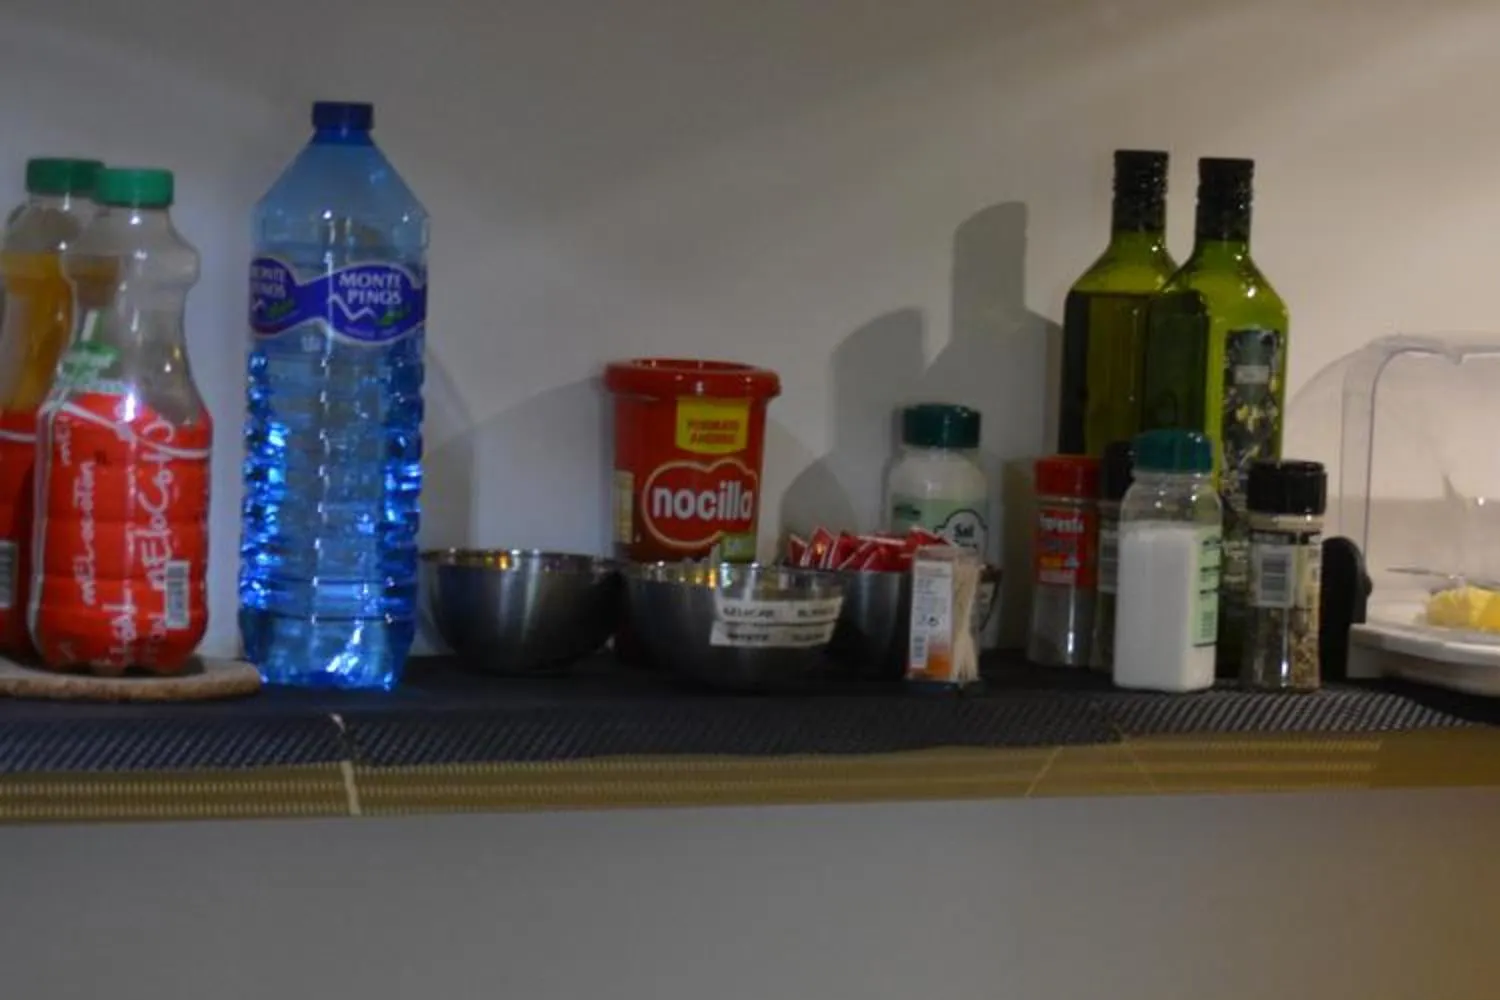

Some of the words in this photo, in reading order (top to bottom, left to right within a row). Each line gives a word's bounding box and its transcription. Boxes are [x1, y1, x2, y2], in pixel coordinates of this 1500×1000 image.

[340, 272, 402, 289] MONTE
[346, 289, 403, 305] PINOS
[652, 481, 753, 520] nocilla
